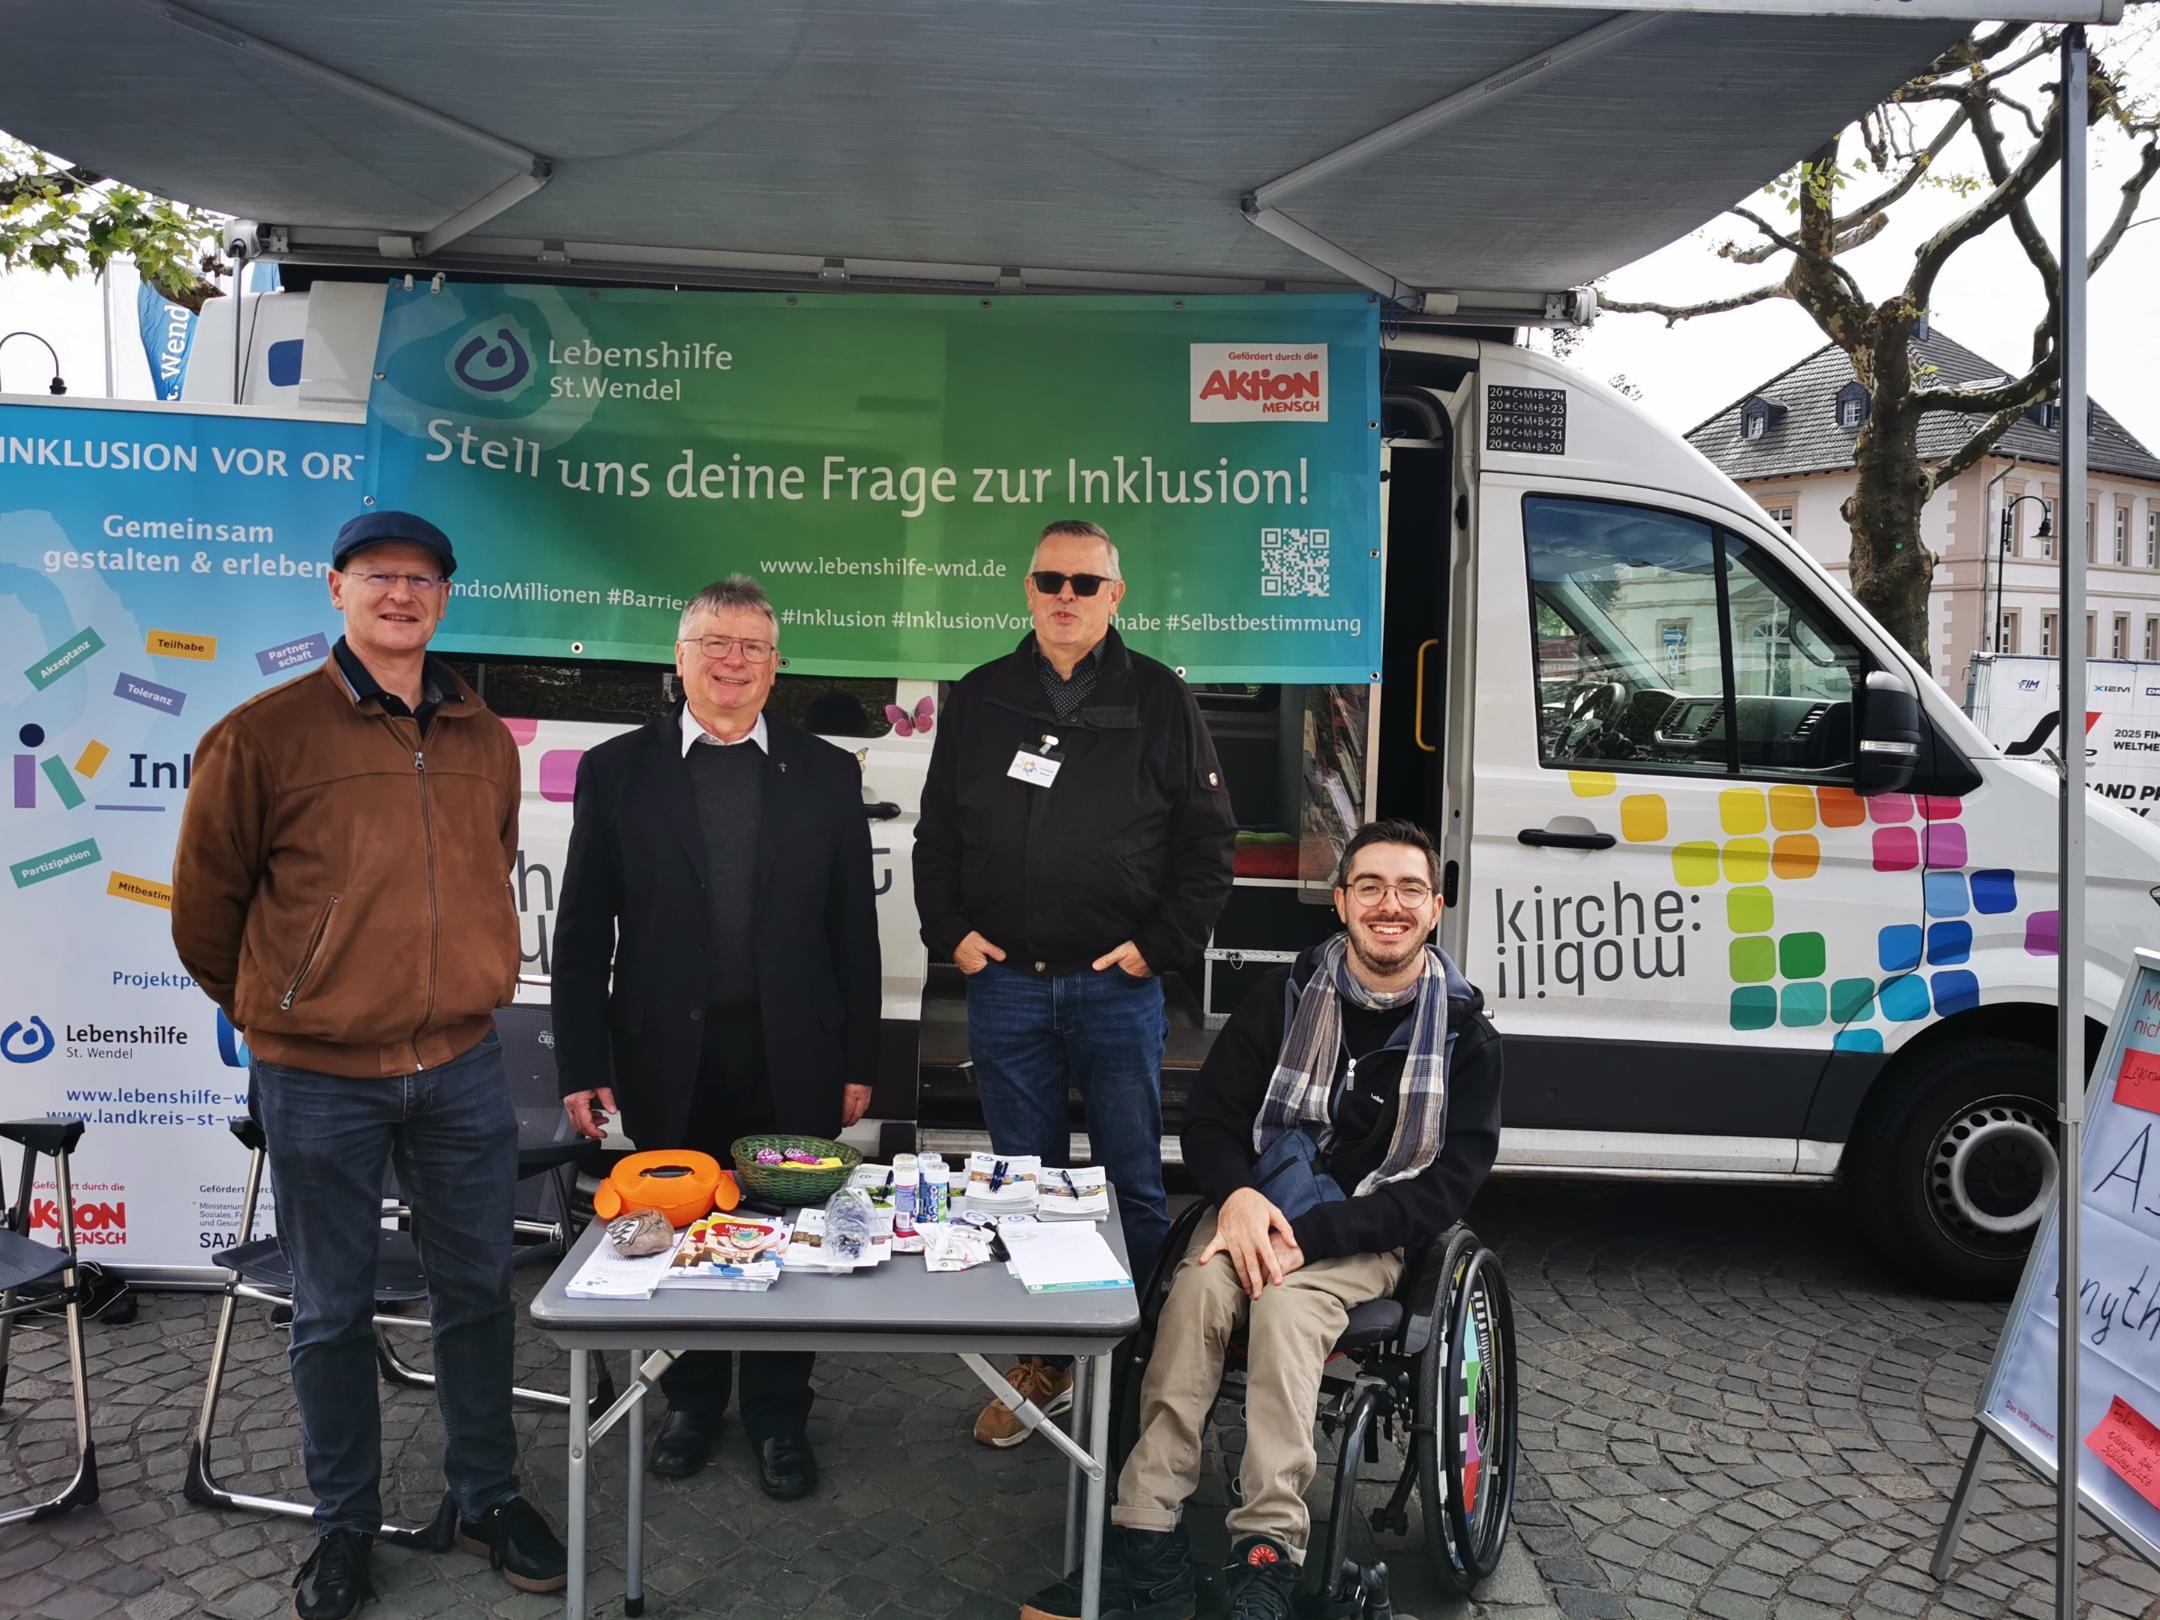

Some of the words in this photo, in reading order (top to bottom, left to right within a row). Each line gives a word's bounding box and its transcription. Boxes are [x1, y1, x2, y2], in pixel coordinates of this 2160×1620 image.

[161, 304, 190, 380] Wend
[548, 339, 734, 371] Lebenshilfe
[1228, 351, 1273, 362] Gefördert
[1275, 351, 1301, 362] durch
[1303, 351, 1318, 361] die
[1262, 401, 1320, 414] MENSCH
[0, 436, 197, 472] INKLUSION
[212, 448, 289, 477] VOR
[426, 417, 540, 478] Stell
[559, 457, 651, 498] uns
[667, 449, 805, 501] deine
[822, 455, 957, 518] Frage
[972, 466, 1052, 505] zur
[1068, 455, 1309, 505] Inklusion!
[103, 514, 274, 543] Gemeinsam
[44, 548, 180, 573] gestalten
[190, 551, 212, 574] &
[222, 554, 331, 579] erleben
[760, 557, 1007, 578] www.lebenshilfe-wnd.de
[449, 579, 600, 604] nd10Millionen
[607, 587, 689, 612] #Barrie
[781, 609, 886, 628] #Inklusion
[891, 610, 1036, 630] #InklusionVor
[1165, 613, 1361, 636] #Selbstbestimmung
[157, 638, 205, 653] Teilhabe
[268, 640, 315, 662] Partner-
[40, 640, 91, 680] Akzeptanz
[278, 650, 313, 669] schaft
[127, 682, 173, 707] Toleranz
[2018, 679, 2040, 689] FIM
[2114, 728, 2141, 738] 2025
[2113, 741, 2160, 752] WELTME
[129, 753, 191, 789] In
[21, 848, 91, 879] Partizipation
[118, 880, 171, 902] Mitbestim
[1496, 881, 1701, 944] kirche:
[66, 1024, 188, 1046] Lebenshilfe
[66, 1047, 83, 1058] St.
[87, 1047, 133, 1060] Wendel
[66, 1088, 249, 1105] www.lebenshilfe-w
[82, 1182, 109, 1191] durch
[110, 1182, 125, 1192] die
[200, 1185, 245, 1194] Gefördert
[200, 1203, 243, 1211] Ministeriu
[200, 1211, 234, 1219] Soziales,
